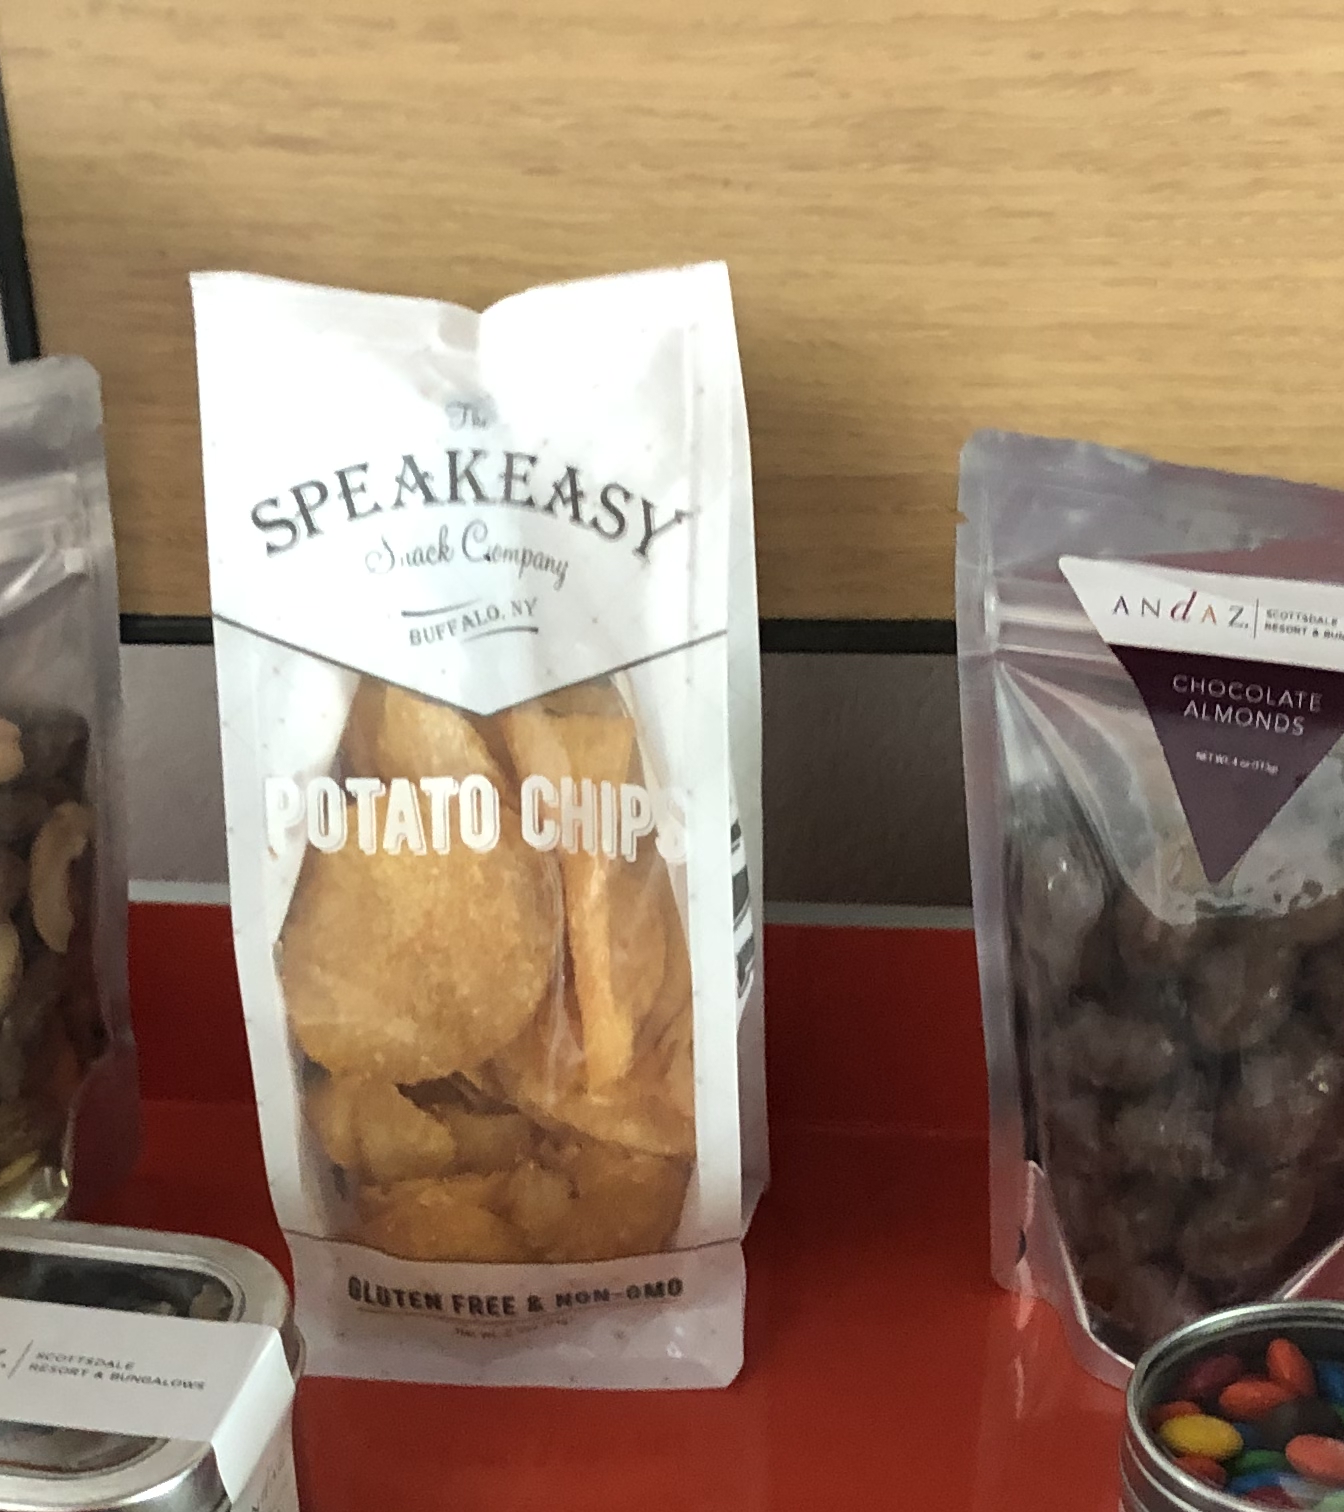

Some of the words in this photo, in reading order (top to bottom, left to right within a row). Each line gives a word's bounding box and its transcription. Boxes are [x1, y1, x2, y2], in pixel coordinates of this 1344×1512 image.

[251, 448, 699, 563] SPEAKEASY
[363, 523, 455, 575] Snack
[461, 519, 569, 591] Company
[408, 604, 507, 647] BUFFALO,
[511, 597, 539, 618] NY
[1172, 674, 1324, 713] CHOCOLATE
[1183, 700, 1306, 737] ALMONDS
[263, 773, 500, 857] POTATO
[519, 773, 690, 863] CHIPS
[348, 1275, 444, 1312] GLUTEN
[452, 1293, 516, 1317] FREE
[527, 1294, 544, 1313] &
[28, 1362, 89, 1377] RESORT
[109, 1372, 206, 1390] BUNGALOWS
[35, 1351, 136, 1372] SCOTTSDALE
